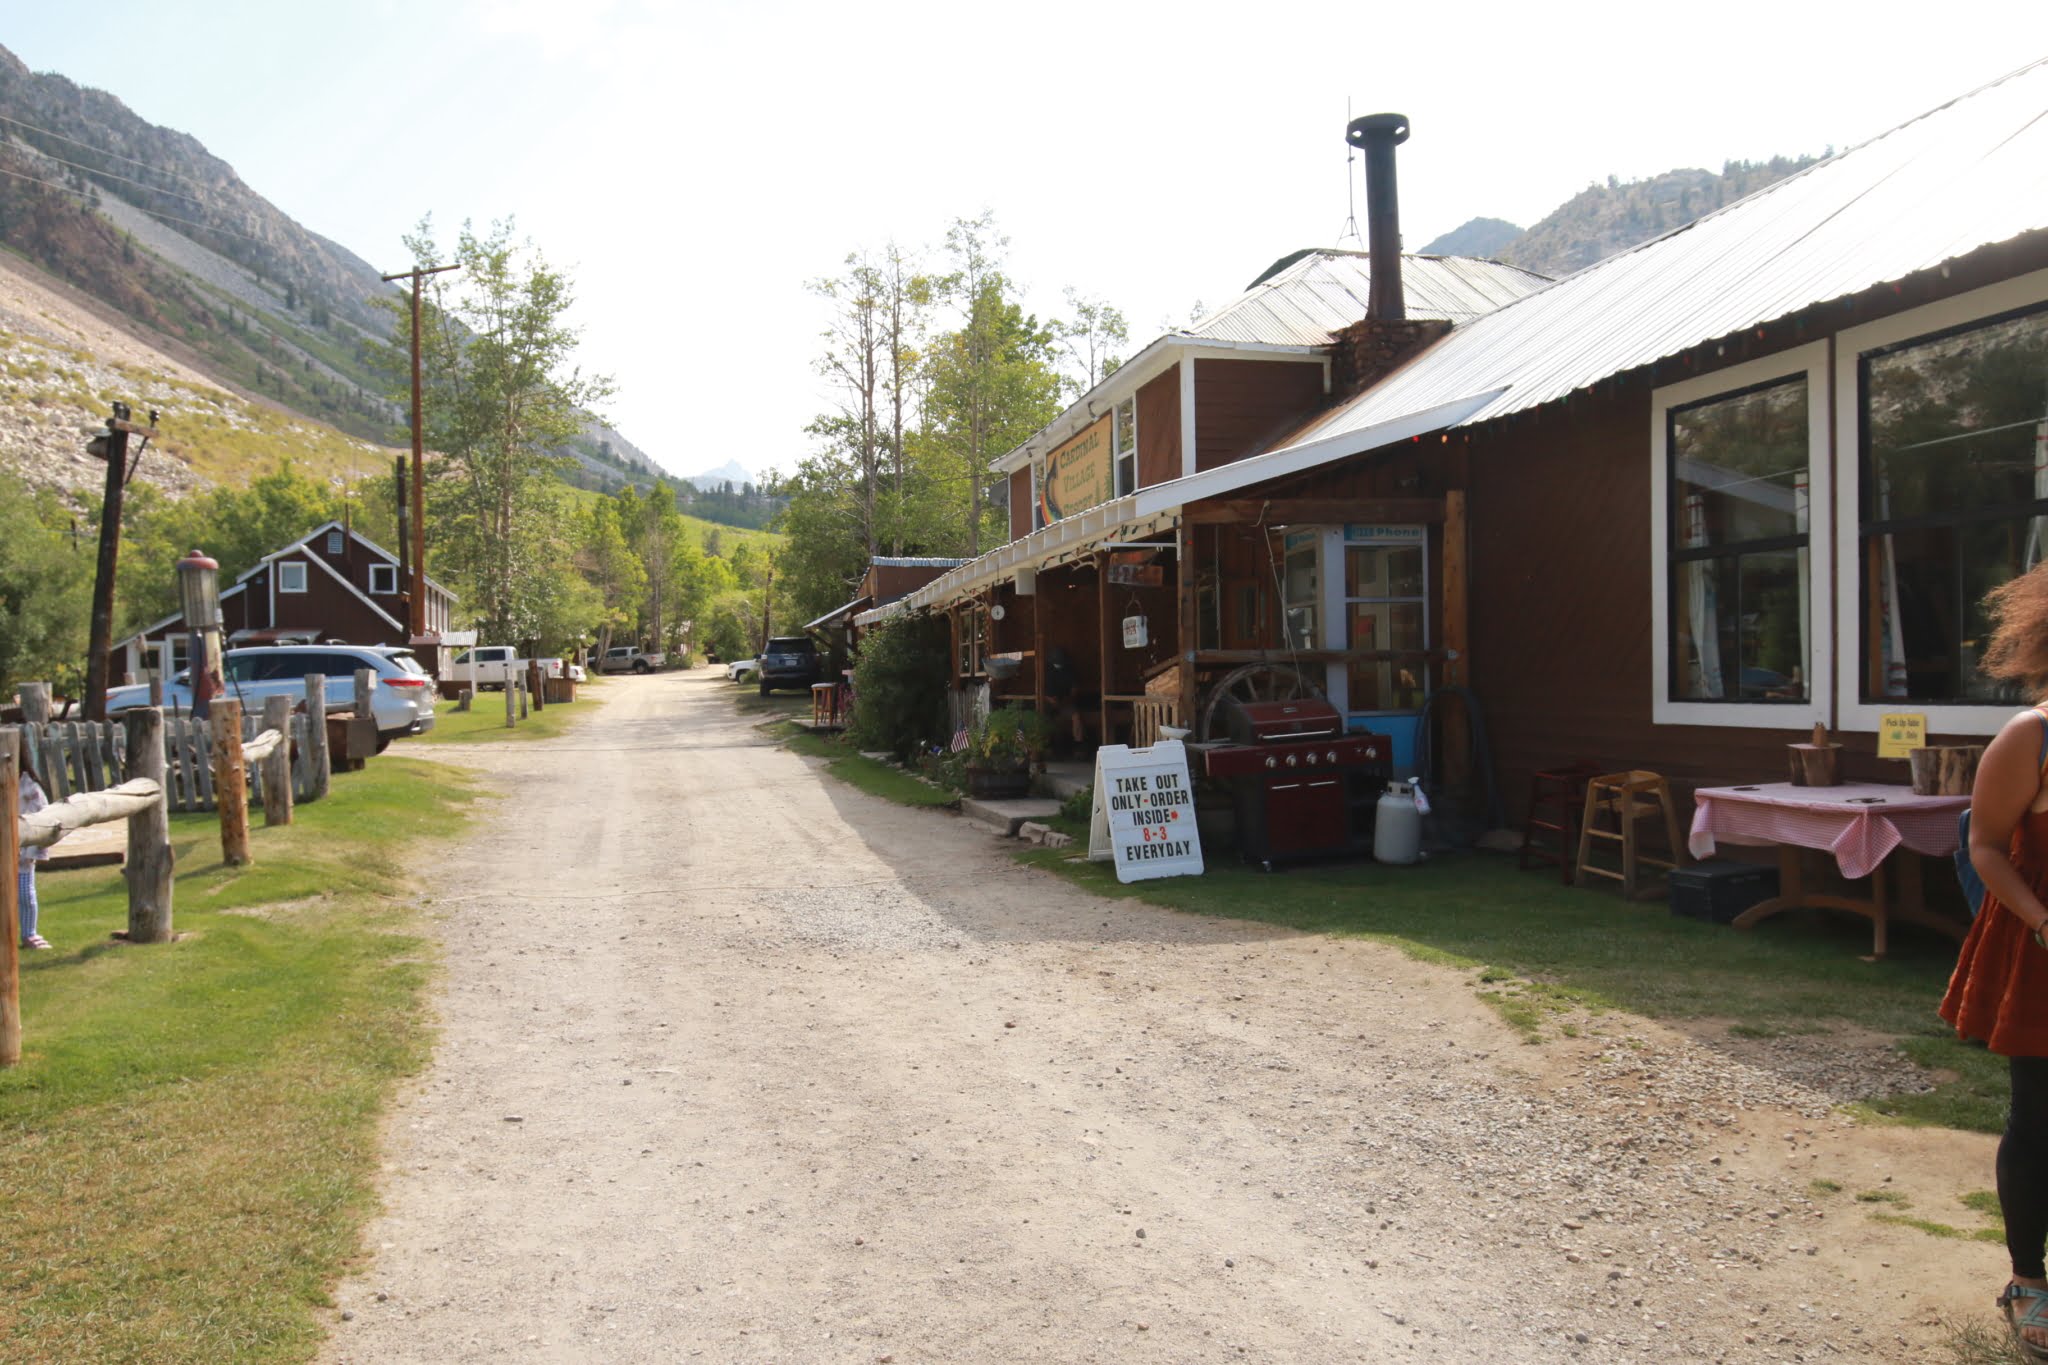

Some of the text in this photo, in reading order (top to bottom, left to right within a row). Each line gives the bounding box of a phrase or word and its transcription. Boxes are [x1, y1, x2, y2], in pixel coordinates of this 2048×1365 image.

[1060, 432, 1100, 469] CARDINAL
[1063, 461, 1096, 493] VILLAGE
[1376, 527, 1420, 537] Phone
[1115, 773, 1179, 793] TAKE OUT
[1132, 809, 1171, 826] INSIDE
[1126, 841, 1191, 861] EVERYDAY
